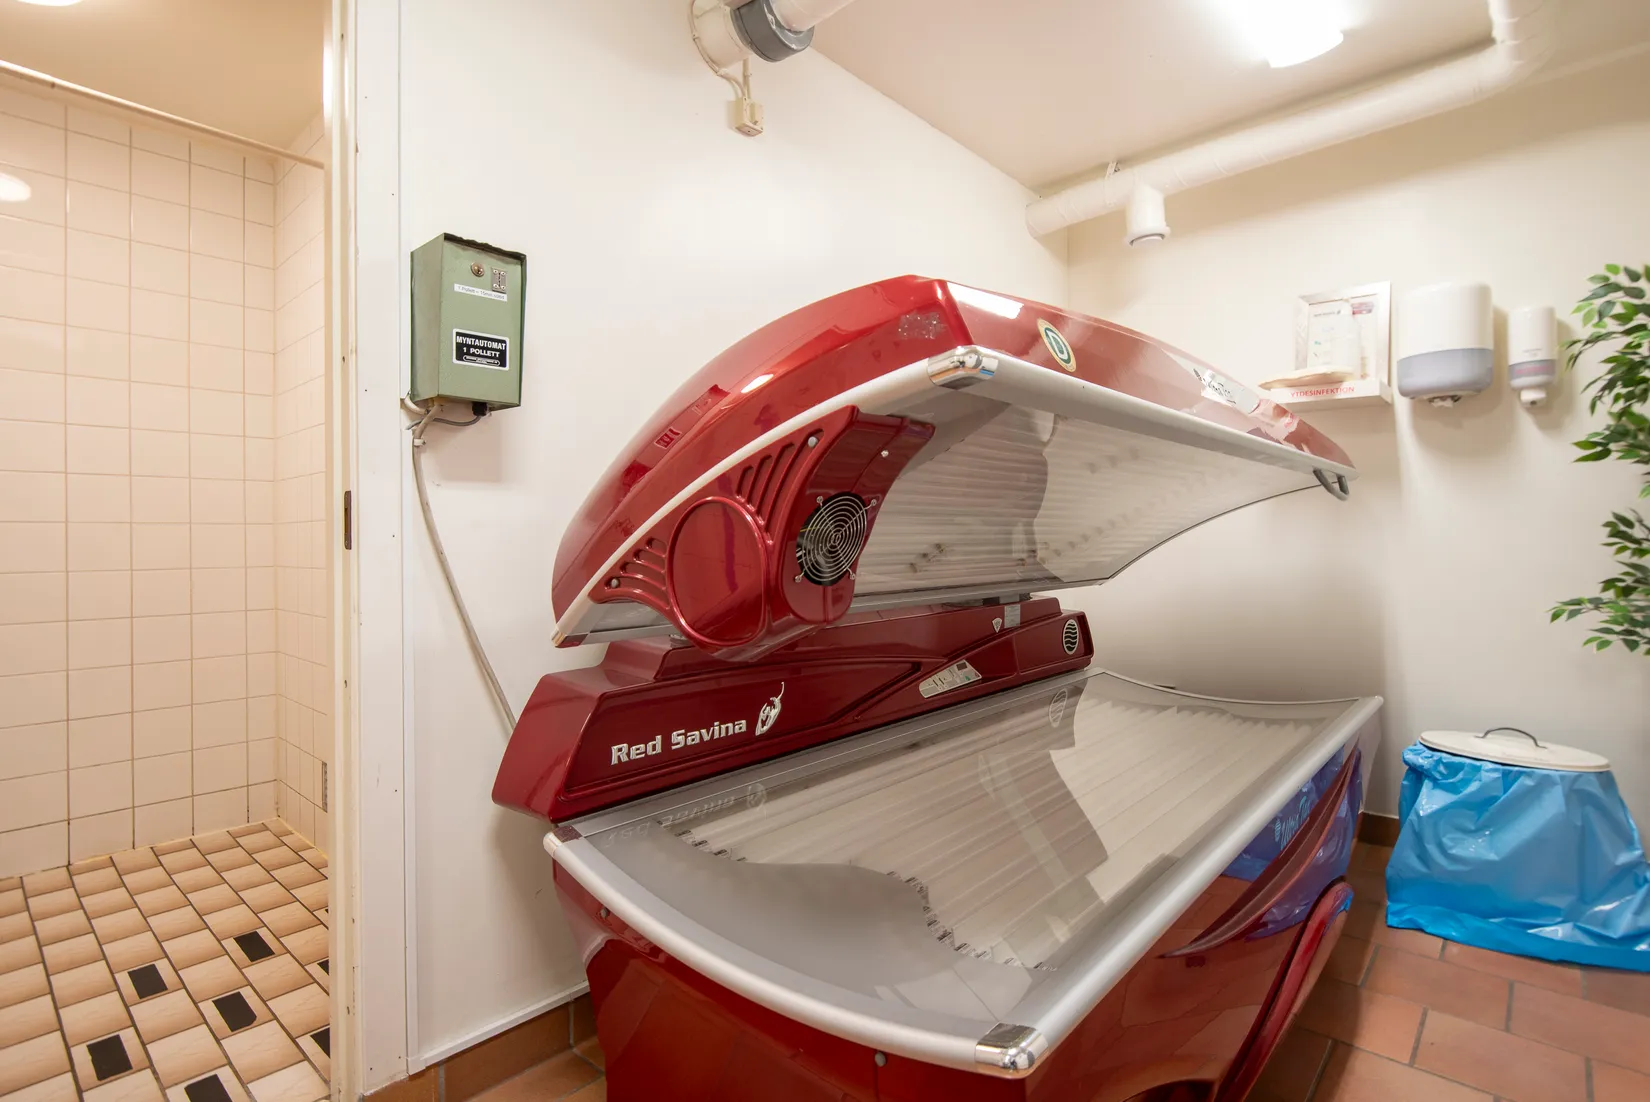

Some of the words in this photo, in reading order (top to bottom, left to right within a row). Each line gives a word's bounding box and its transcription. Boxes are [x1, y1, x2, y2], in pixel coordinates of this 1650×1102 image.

[456, 335, 506, 350] MYNTAUTOMAT
[470, 347, 500, 358] POLLETT
[1291, 386, 1355, 398] YTDESINFEKTION
[610, 734, 663, 766] Red
[671, 719, 747, 750] Savina
